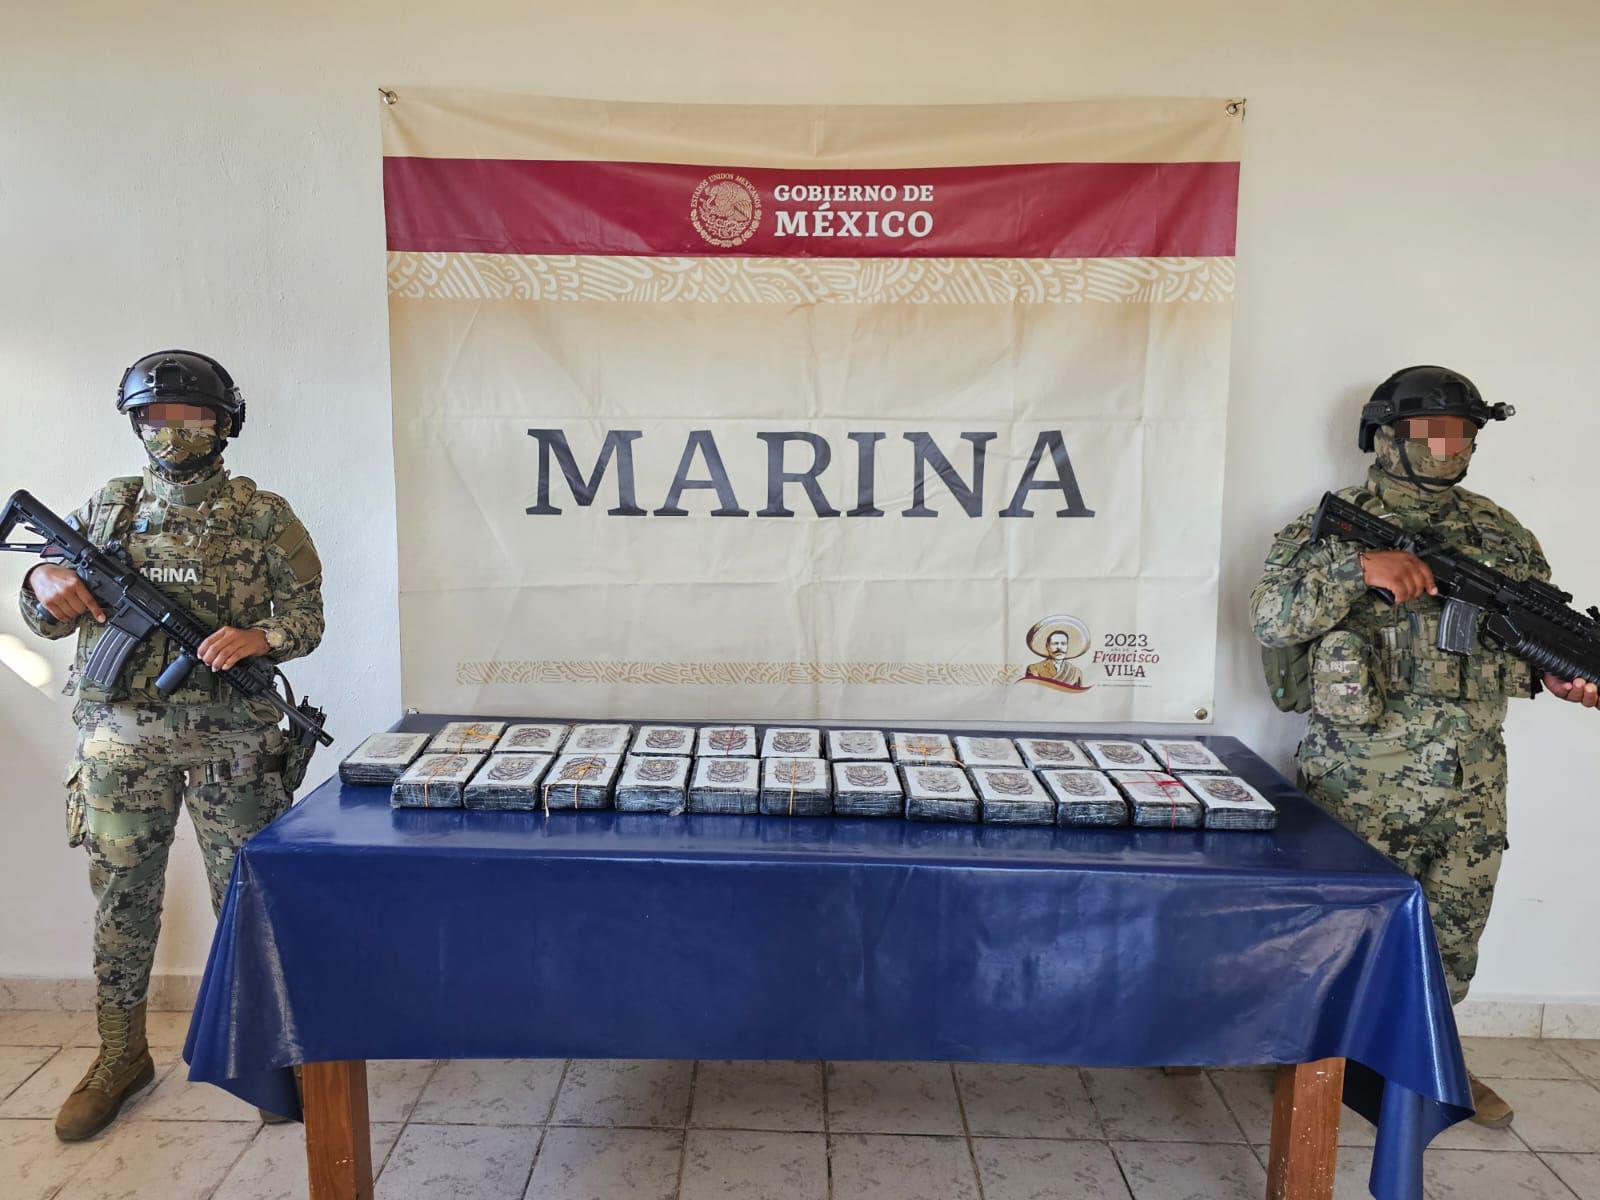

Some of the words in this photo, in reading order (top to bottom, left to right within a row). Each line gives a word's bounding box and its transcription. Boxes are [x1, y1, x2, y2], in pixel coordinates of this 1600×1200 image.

[690, 179, 708, 207] ESTADOS
[709, 172, 734, 182] UNIDOS
[735, 175, 762, 208] MEXICANOS
[773, 184, 897, 202] GOBIERNO
[902, 184, 934, 202] DE
[773, 202, 934, 237] MÉXICO
[525, 427, 1096, 519] MARINA
[139, 567, 198, 582] ARINA
[1104, 633, 1148, 647] 2023
[1092, 648, 1160, 664] Francisco
[1104, 665, 1146, 677] VILLA
